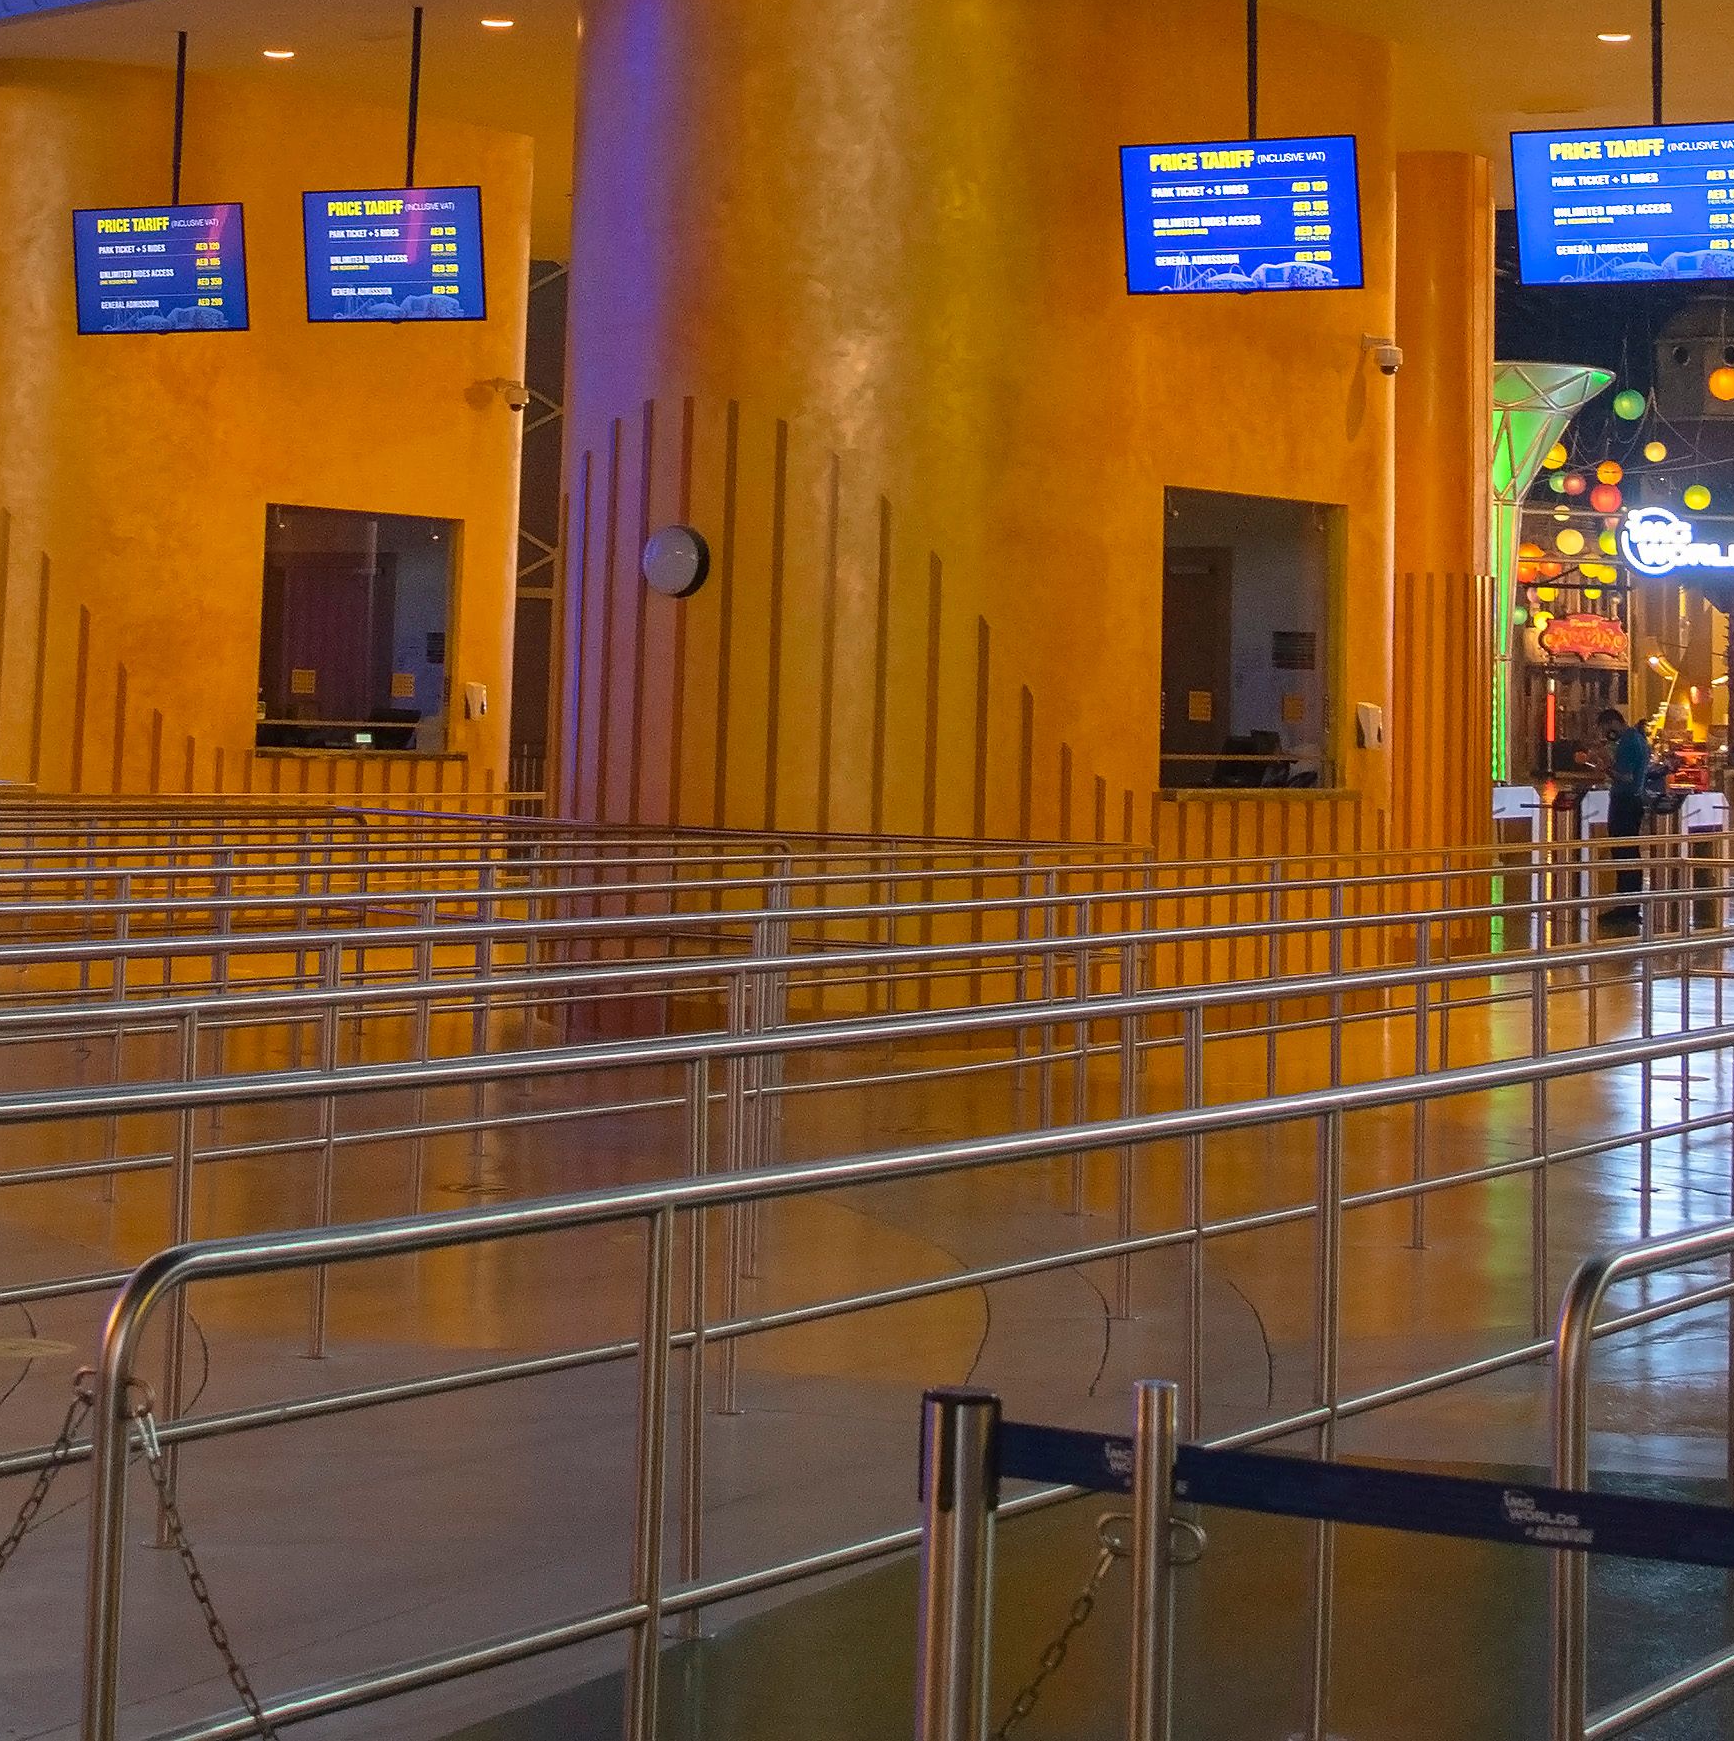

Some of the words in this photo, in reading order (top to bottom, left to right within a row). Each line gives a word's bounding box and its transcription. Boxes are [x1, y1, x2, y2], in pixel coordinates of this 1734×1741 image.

[1549, 141, 1602, 161] PRICE
[1604, 138, 1665, 159] TARIFF
[1667, 141, 1719, 153] (INCLUSIVE
[1150, 152, 1198, 172] PRICE
[1199, 150, 1254, 171] TARIFF
[1257, 153, 1304, 165] (INCLUSIVE
[1306, 152, 1326, 162] VAT)
[1552, 177, 1576, 187] PARK
[1577, 175, 1610, 186] TICKET
[1151, 188, 1175, 198] PARK
[1175, 186, 1205, 197] TICKET
[327, 201, 362, 217] PRICE
[364, 200, 404, 215] TARIFF
[405, 203, 440, 213] (INCLUSIVE
[440, 202, 455, 211] VAT)
[97, 218, 130, 234] PRICE
[132, 216, 169, 232] TARIFF
[171, 220, 204, 228] (INCLUSIVE
[204, 219, 218, 227] VAT)
[329, 230, 345, 238] PARK
[345, 229, 367, 238] TICKET
[99, 246, 114, 254] PARK
[115, 245, 135, 253] TICKET
[1509, 1509, 1579, 1527] WORLDS
